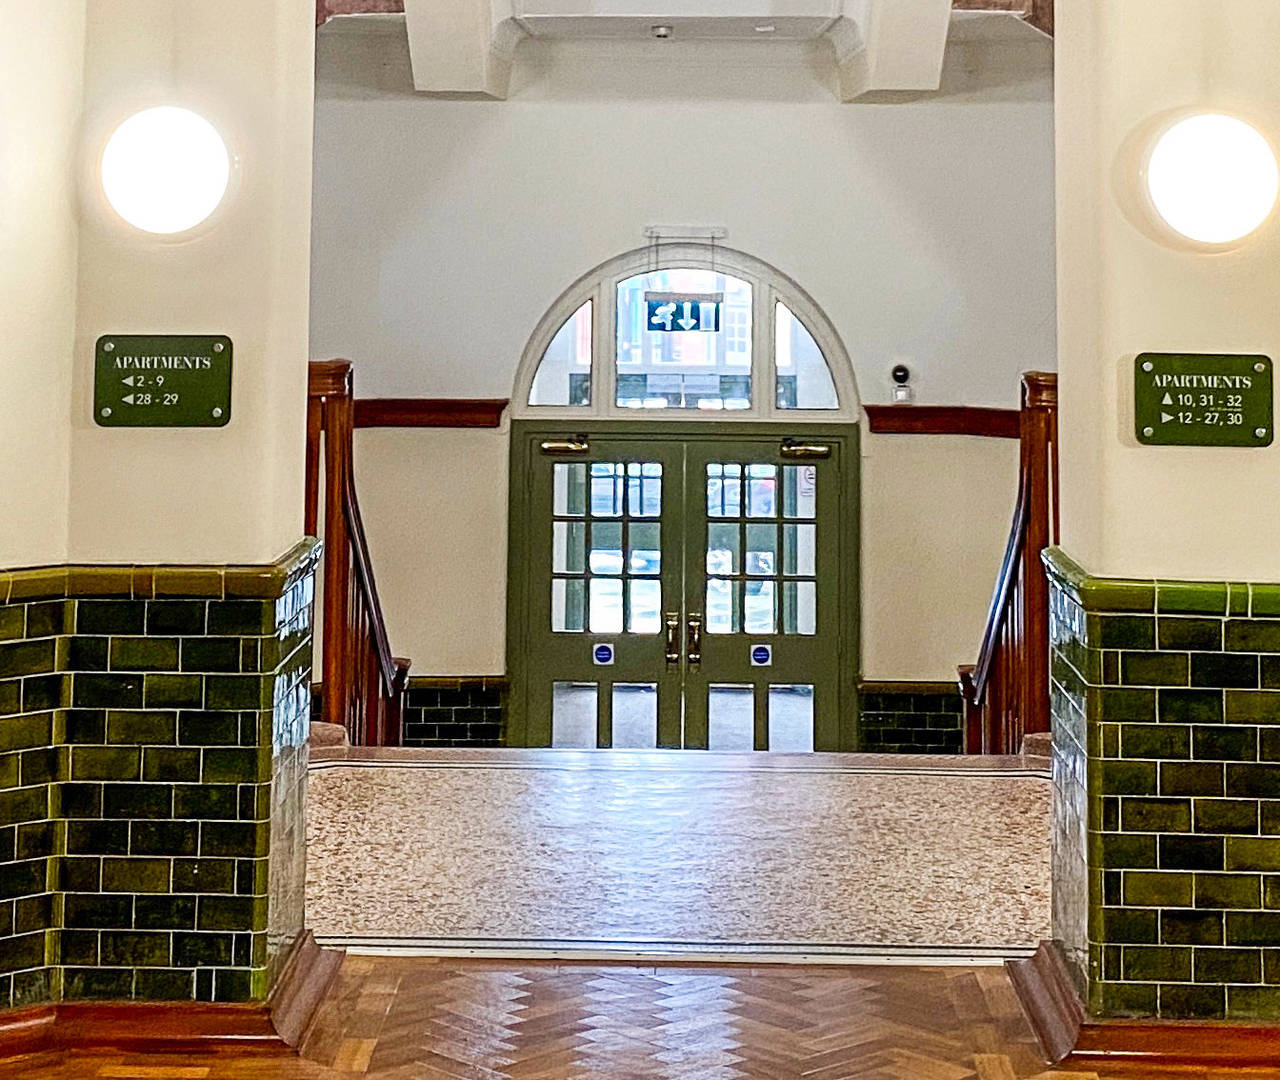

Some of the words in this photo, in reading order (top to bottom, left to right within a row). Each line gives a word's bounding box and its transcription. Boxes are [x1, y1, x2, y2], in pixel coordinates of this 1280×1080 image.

[114, 356, 210, 369] APARTMENTS
[136, 376, 144, 386] 2
[156, 375, 164, 386] 9
[1153, 375, 1252, 388] APARTMENTS
[136, 394, 151, 404] 28
[164, 394, 178, 404] 29
[1178, 394, 1196, 408] 10,
[1200, 394, 1213, 406] 31
[1227, 395, 1242, 407] 32
[1178, 412, 1192, 423] 12
[1205, 412, 1223, 425] 27,
[1227, 413, 1242, 425] 30
